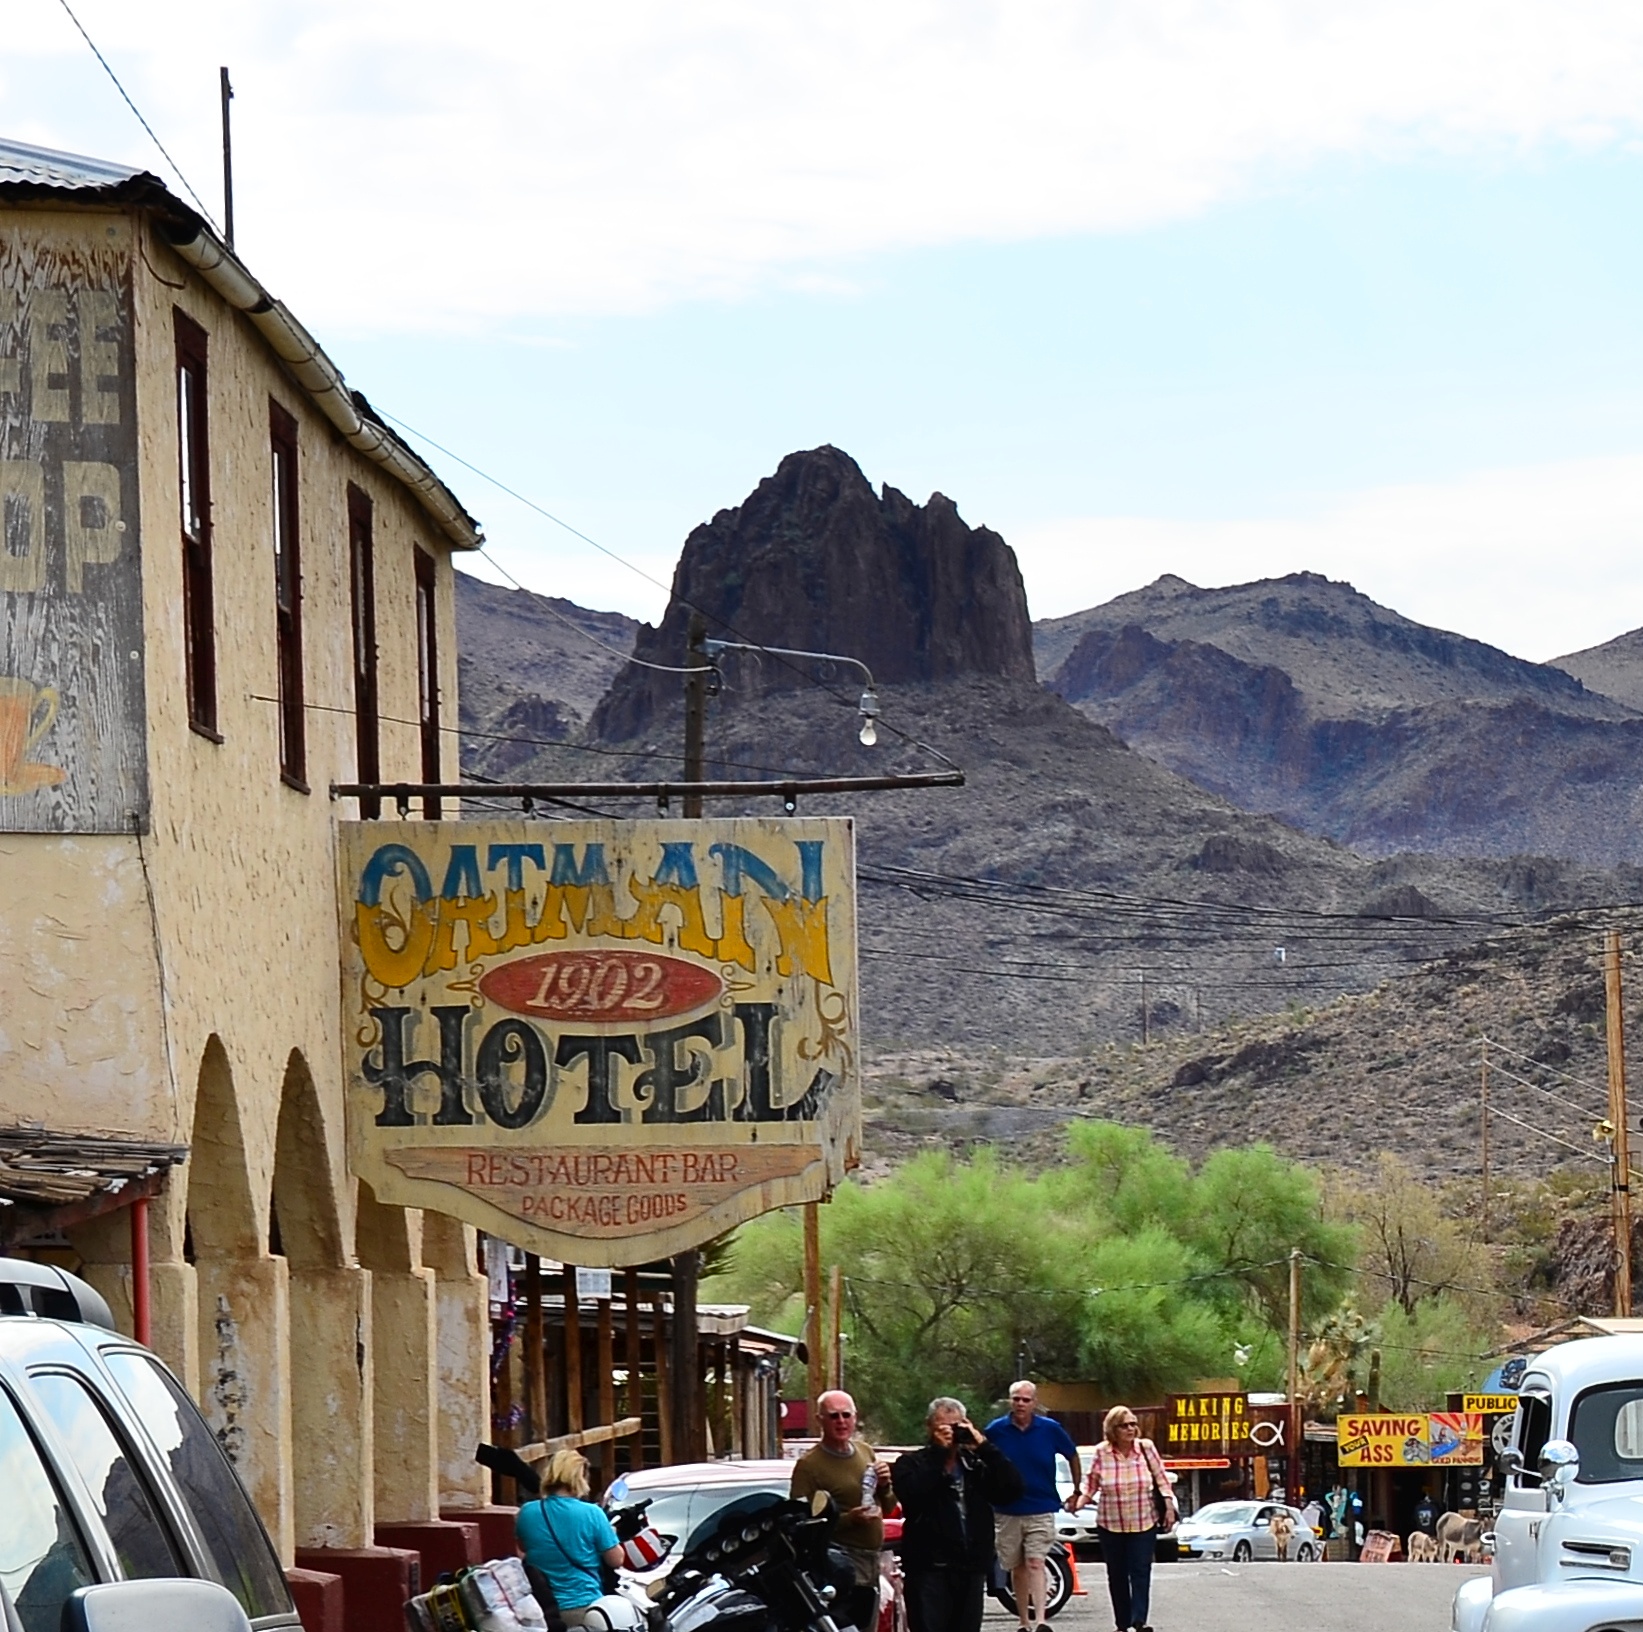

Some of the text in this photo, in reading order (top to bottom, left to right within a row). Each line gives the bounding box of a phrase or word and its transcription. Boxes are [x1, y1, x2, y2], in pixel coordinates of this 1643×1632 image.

[355, 840, 834, 988] OATMAN
[526, 961, 665, 1010] 1902
[362, 1002, 836, 1129] HOTEL
[522, 1192, 688, 1226] PACKAGE GOODS
[1176, 1397, 1244, 1418] MAKING
[1466, 1397, 1517, 1410] PUBLIC
[1168, 1421, 1250, 1442] MEMORIES
[1347, 1419, 1421, 1437] SAVING
[1360, 1444, 1394, 1463] ASS
